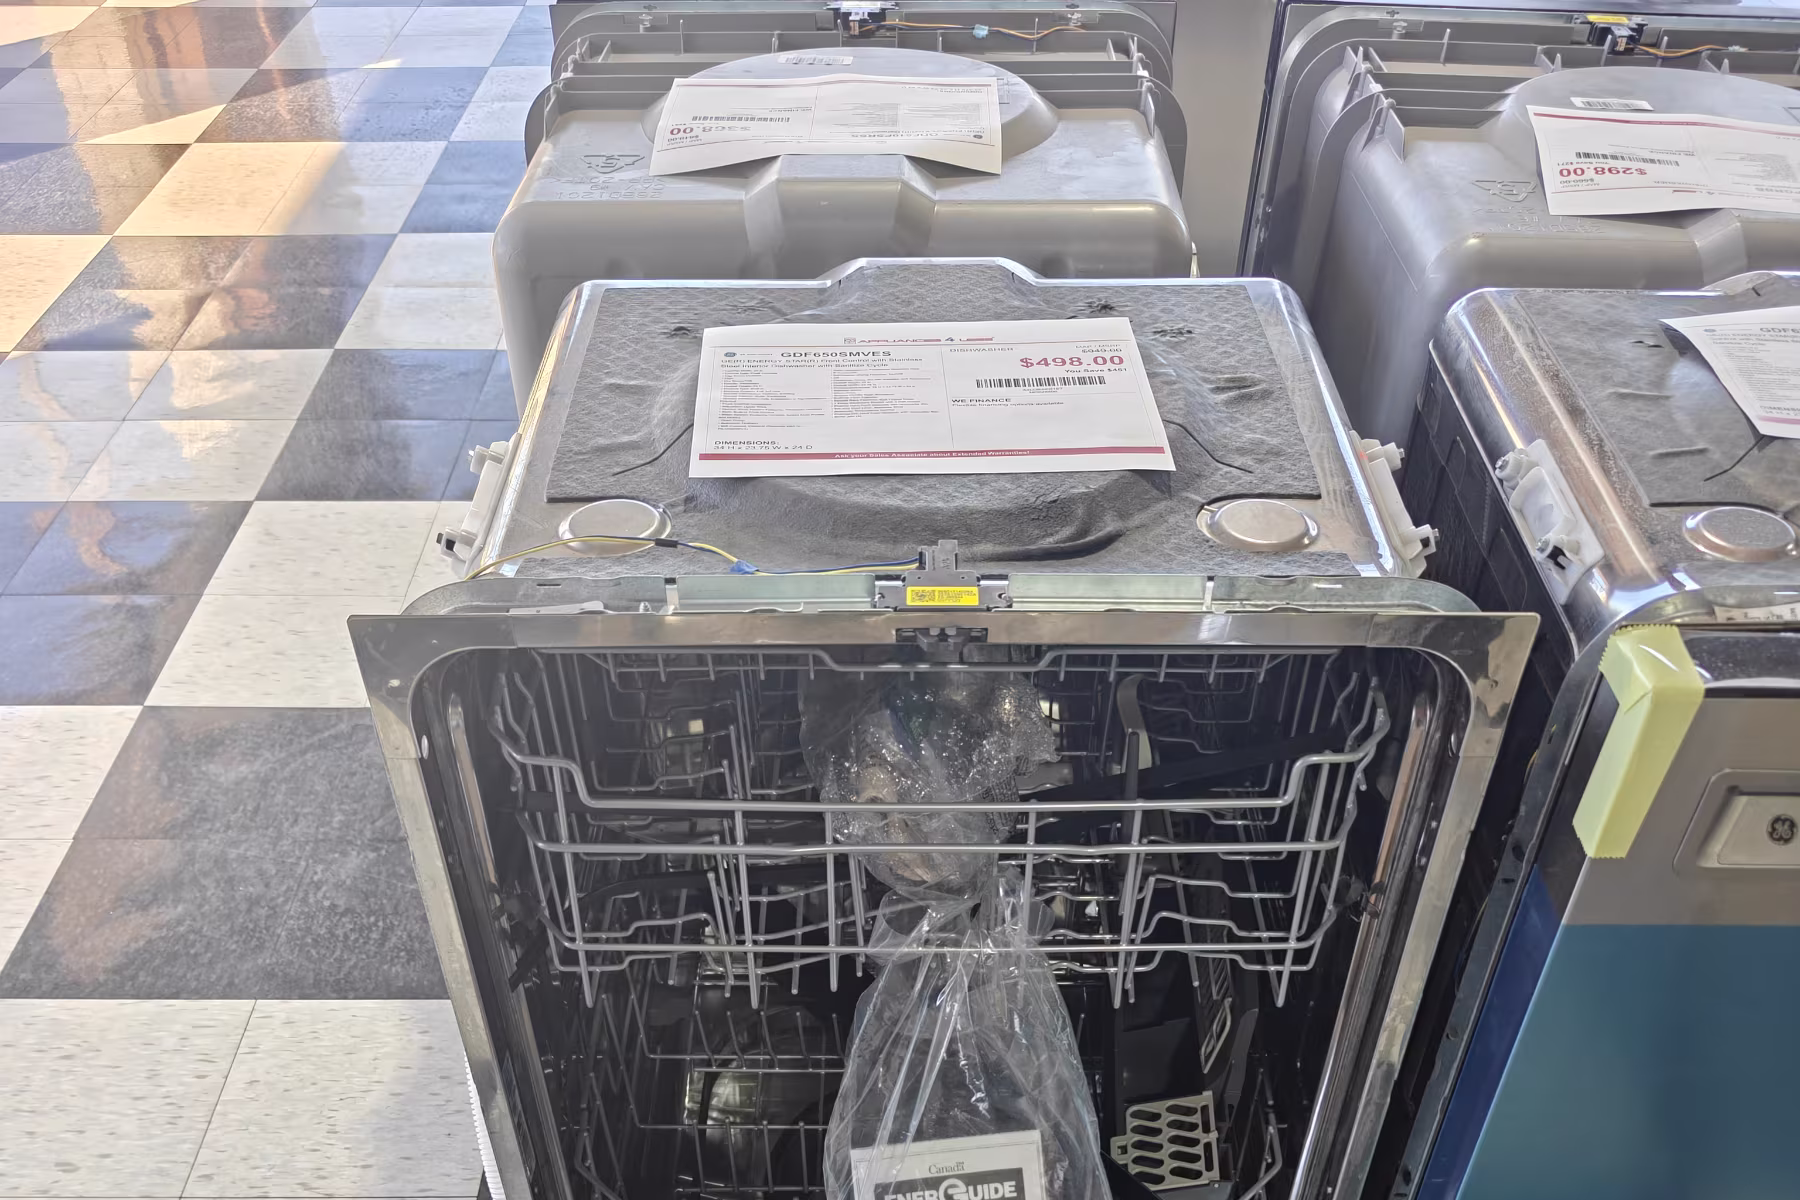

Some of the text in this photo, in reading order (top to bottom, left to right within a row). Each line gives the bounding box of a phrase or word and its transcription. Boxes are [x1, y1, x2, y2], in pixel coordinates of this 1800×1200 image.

[1559, 167, 1648, 178] $298.00
[780, 350, 892, 358] GDF650SMVES
[1019, 355, 1125, 369] $498.00
[928, 1162, 966, 1176] Canada
